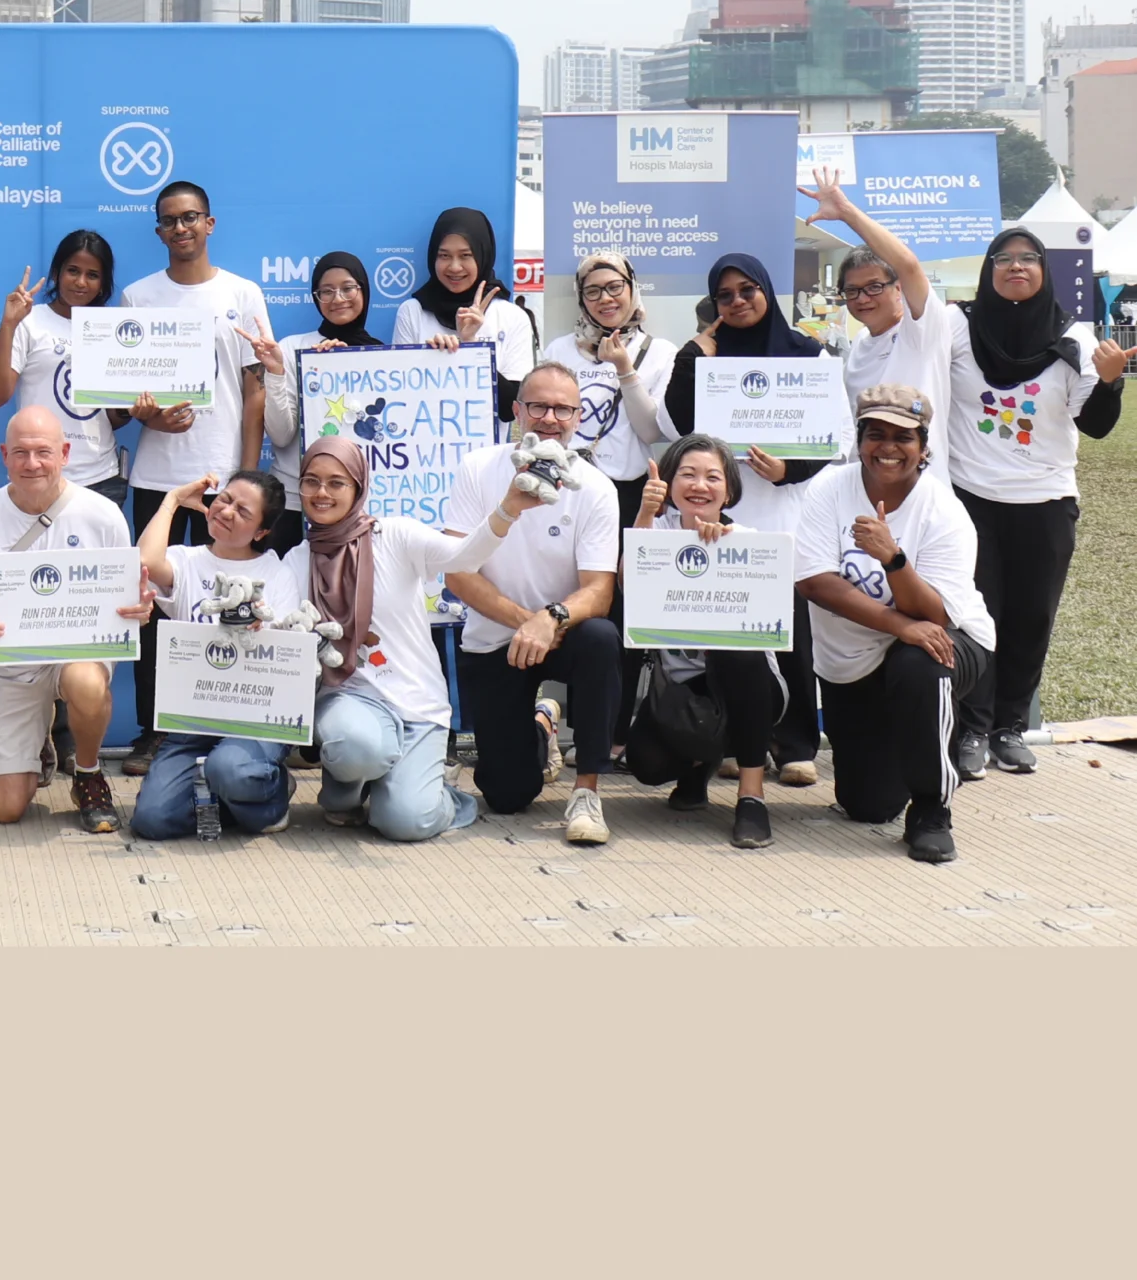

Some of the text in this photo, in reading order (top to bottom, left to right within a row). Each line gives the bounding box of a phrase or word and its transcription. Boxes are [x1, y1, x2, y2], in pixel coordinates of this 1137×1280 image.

[101, 105, 170, 116] SUPPORTING
[46, 121, 63, 136] of
[676, 126, 714, 135] Center of
[629, 127, 673, 151] HM
[677, 135, 714, 143] Palliative
[677, 143, 696, 151] Care
[629, 160, 714, 173] Hospis Malaysia
[864, 175, 981, 191] EDUCATION &
[864, 191, 948, 207] TRAINING
[98, 204, 149, 213] PALLIATIVE
[573, 201, 653, 215] We believe
[572, 215, 699, 232] everyone in need
[573, 229, 719, 243] should have access
[573, 244, 588, 257] to
[660, 244, 697, 257] care.
[261, 256, 310, 283] HM
[263, 293, 301, 307] Hospis
[107, 358, 178, 368] RUN FOR A REASON
[303, 365, 491, 398] COMPASSIONATE
[382, 399, 488, 440] CARE
[731, 409, 805, 420] RUN FOR A REASON
[716, 548, 748, 565] HM
[666, 589, 750, 603] RUN FOR A REASON
[21, 605, 100, 620] RUN FOR A REASON
[195, 679, 275, 697] RUN FOR A REASON
